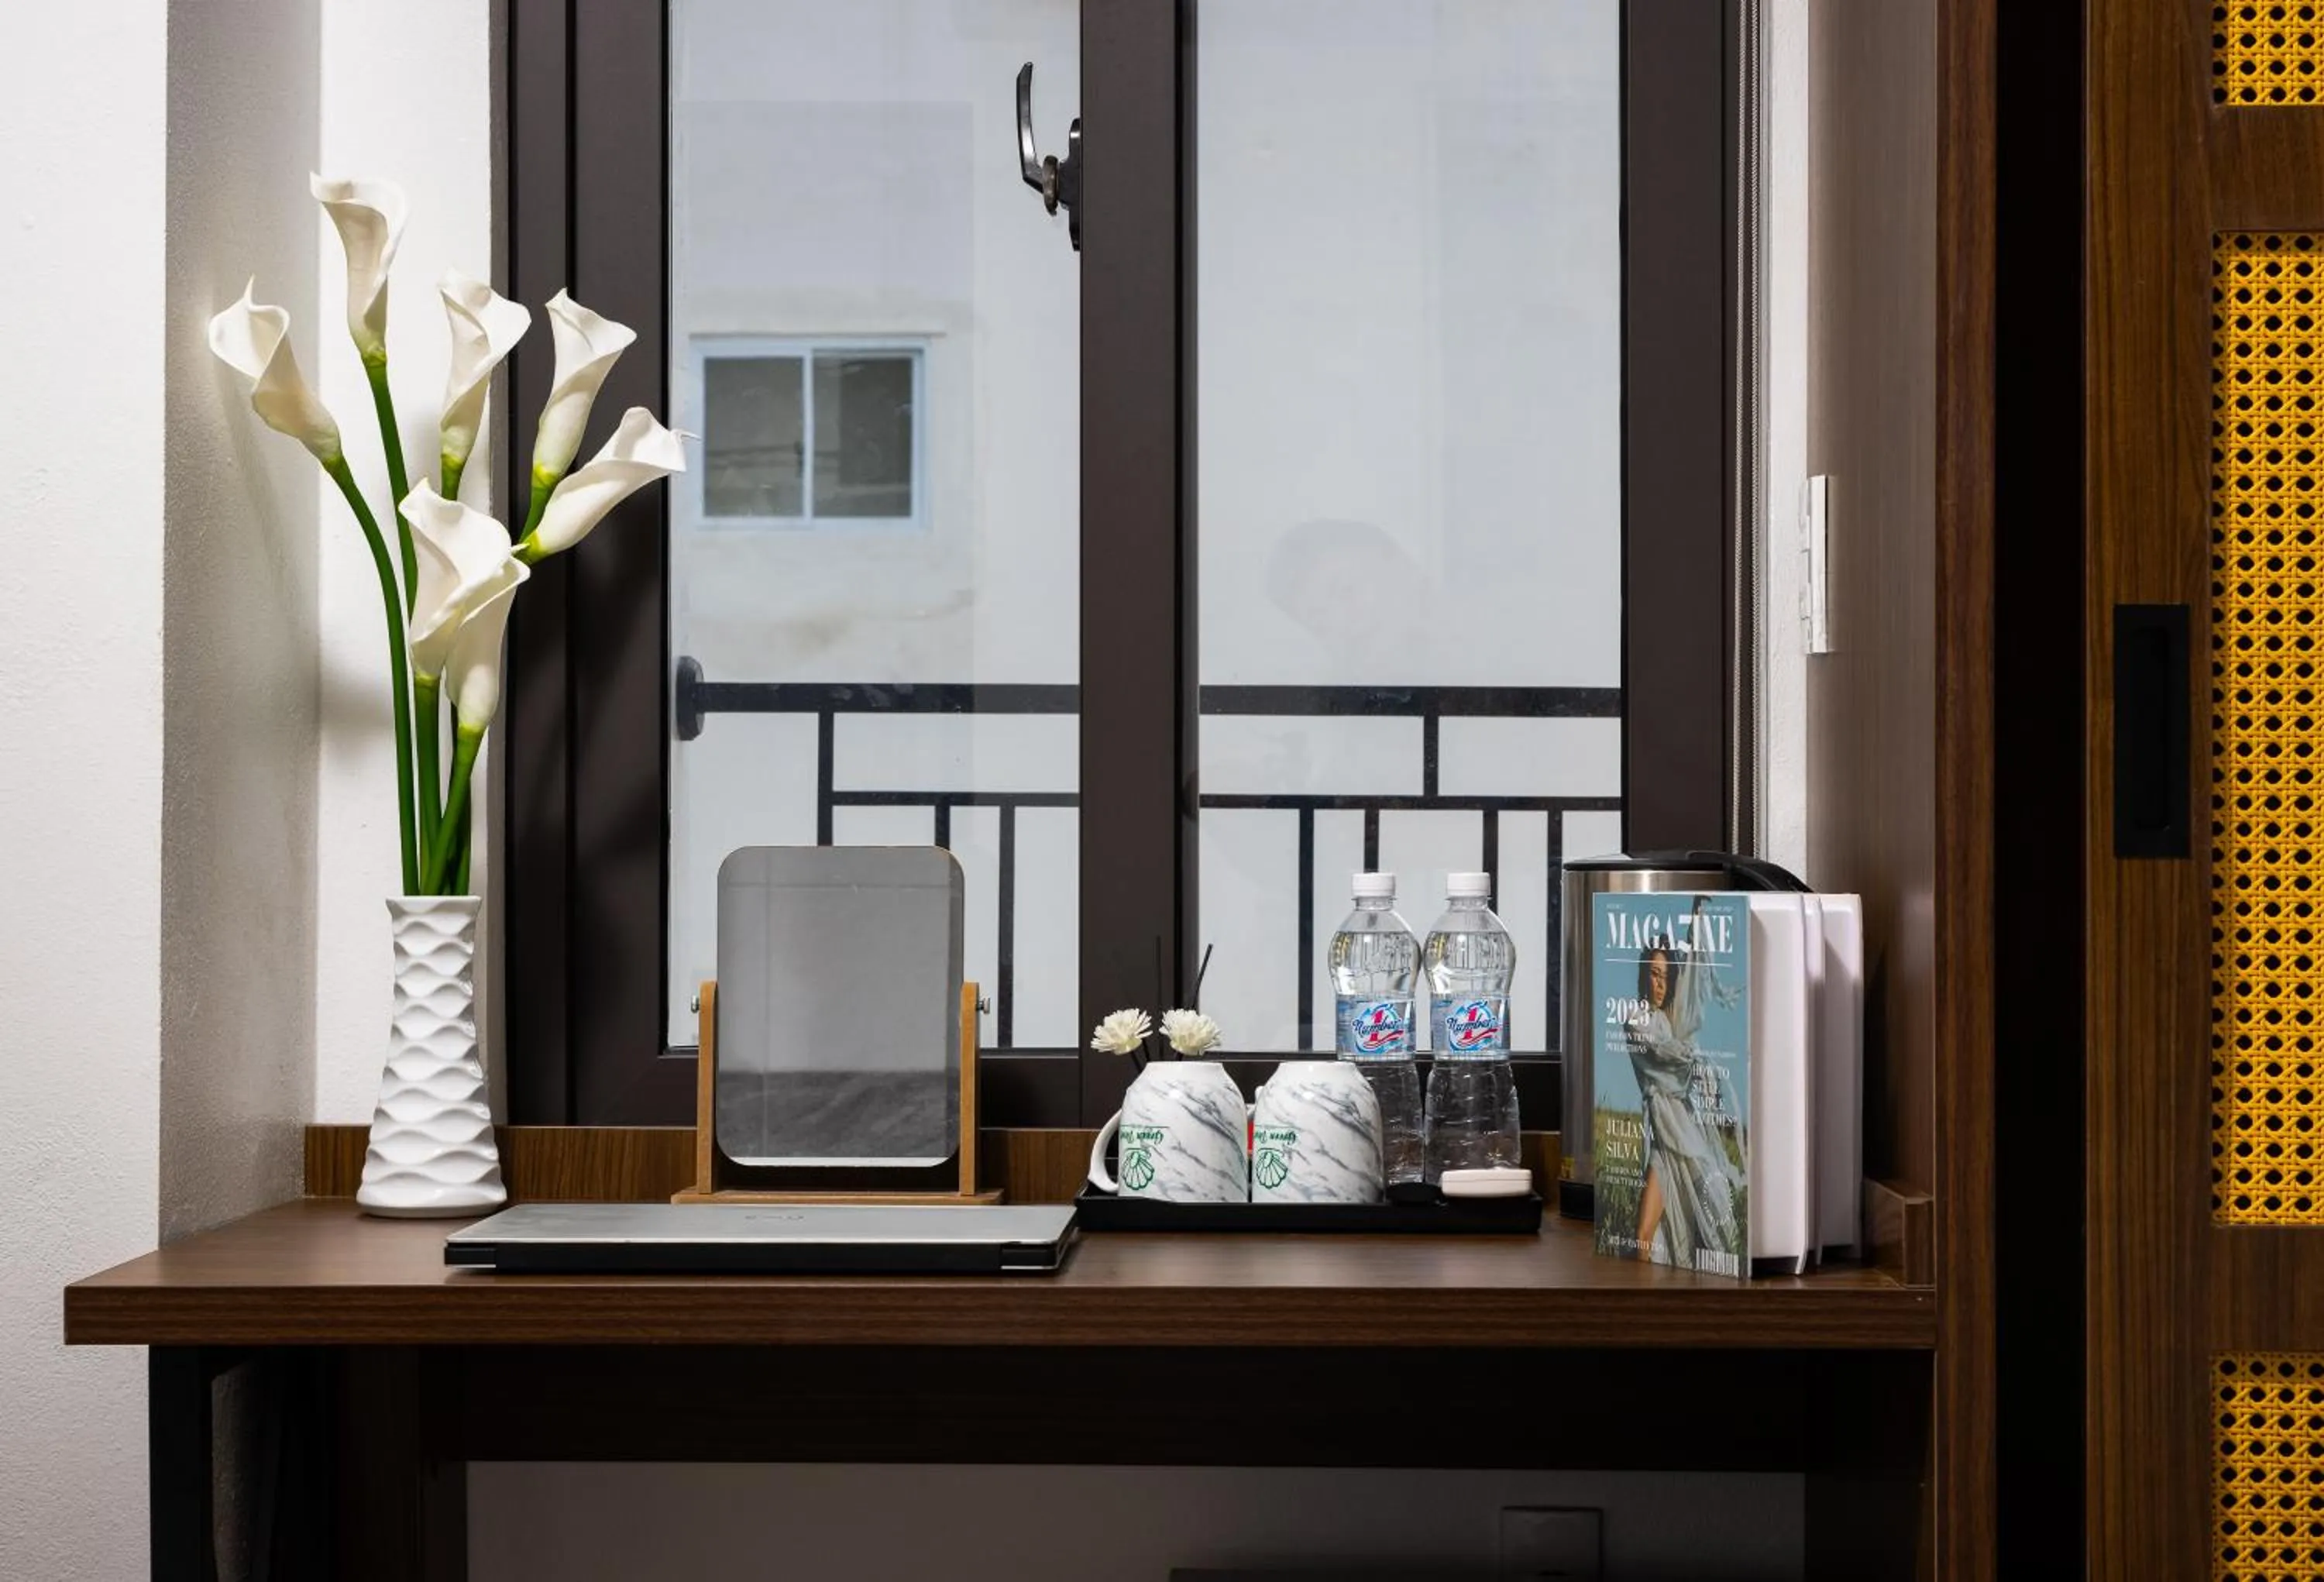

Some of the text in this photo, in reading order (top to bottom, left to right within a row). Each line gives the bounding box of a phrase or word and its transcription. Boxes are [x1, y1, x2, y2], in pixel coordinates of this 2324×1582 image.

[1606, 912, 1733, 953] MAGAZINE
[1606, 996, 1650, 1027] 2023
[1606, 1119, 1655, 1140] JULIANA
[1606, 1140, 1640, 1161] SILVA
